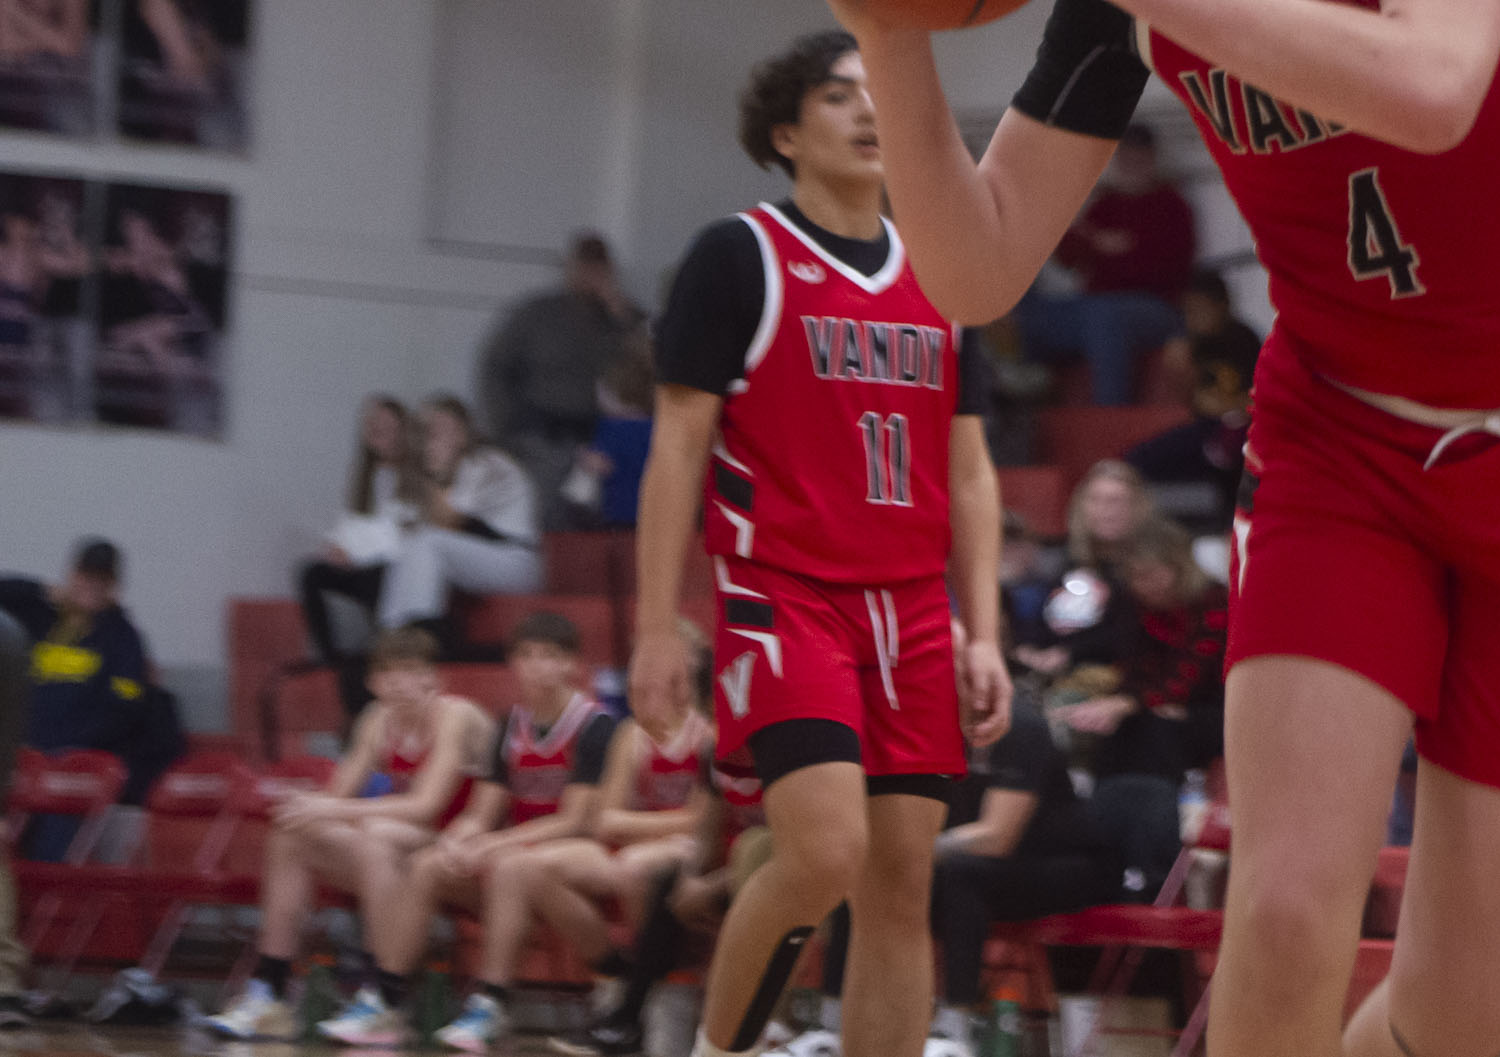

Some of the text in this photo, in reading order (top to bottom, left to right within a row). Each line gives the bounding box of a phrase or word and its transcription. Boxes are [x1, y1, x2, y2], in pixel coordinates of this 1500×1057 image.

[1347, 166, 1426, 300] 4
[800, 315, 948, 391] VANDY
[856, 410, 914, 507] 11
